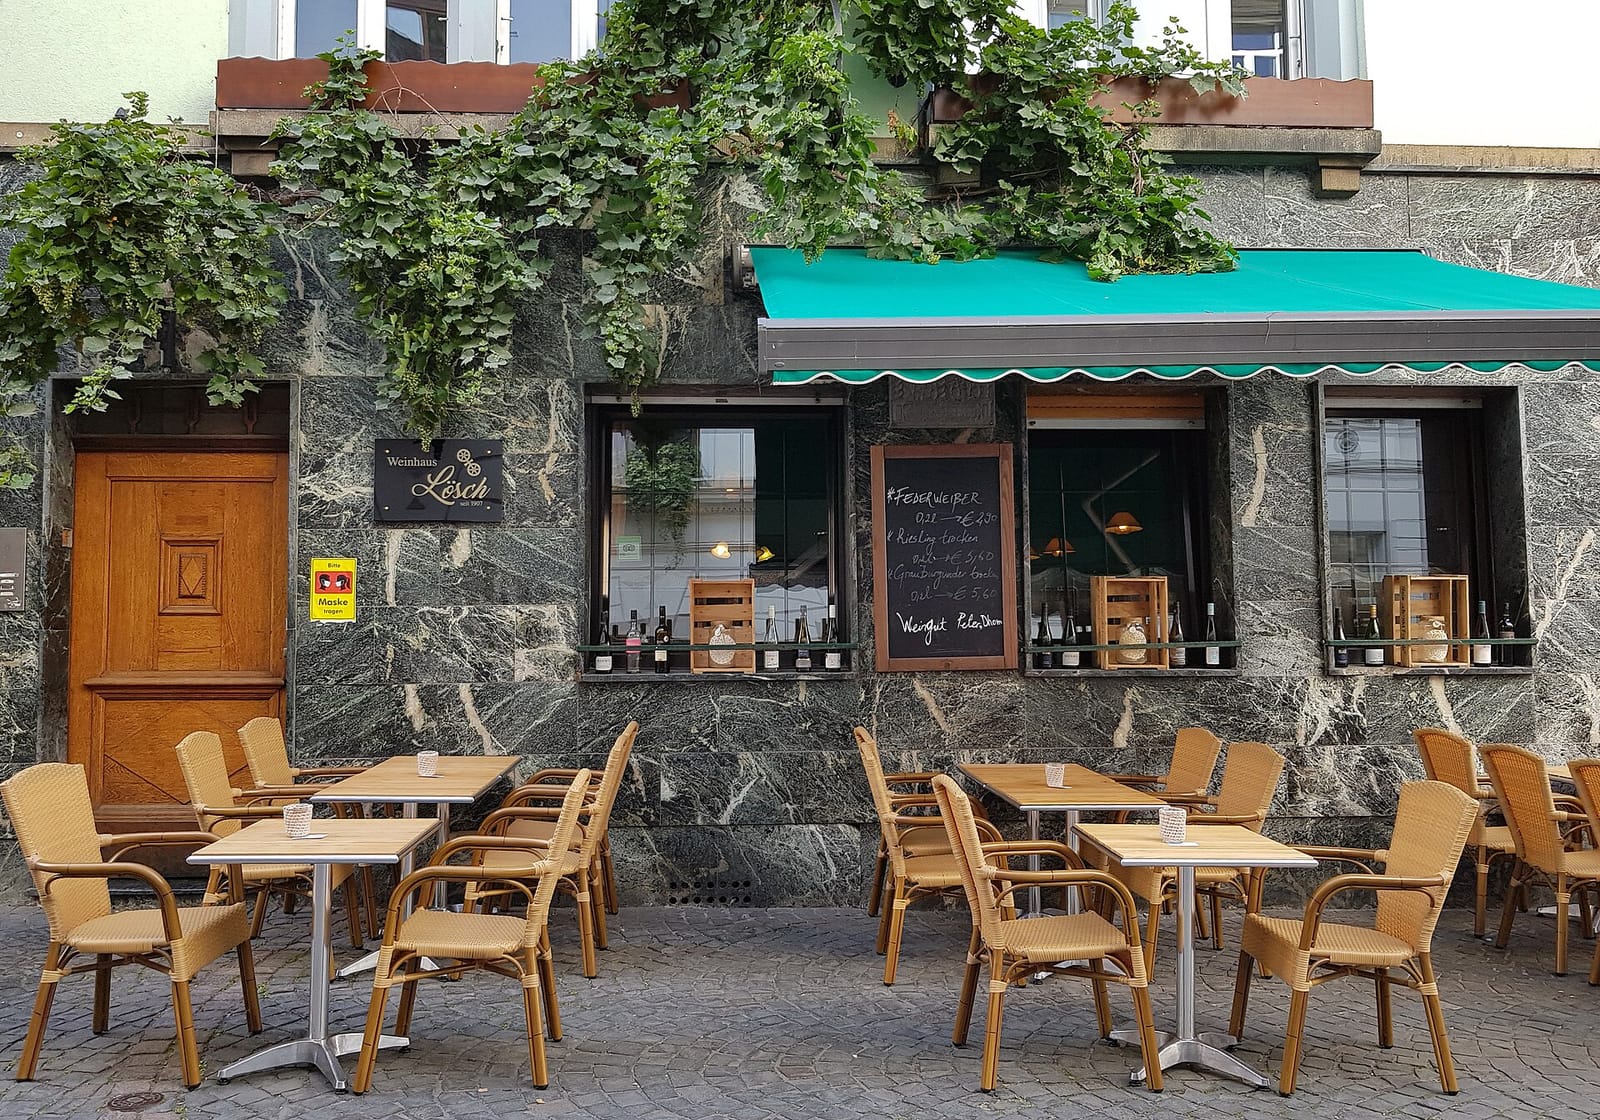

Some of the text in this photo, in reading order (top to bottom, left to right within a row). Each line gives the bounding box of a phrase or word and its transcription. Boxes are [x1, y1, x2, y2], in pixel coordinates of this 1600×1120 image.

[387, 456, 438, 467] Weinhaus
[411, 465, 491, 506] Lösch
[939, 529, 979, 545] trocken
[318, 597, 349, 606] Maske
[896, 612, 948, 646] Weingut
